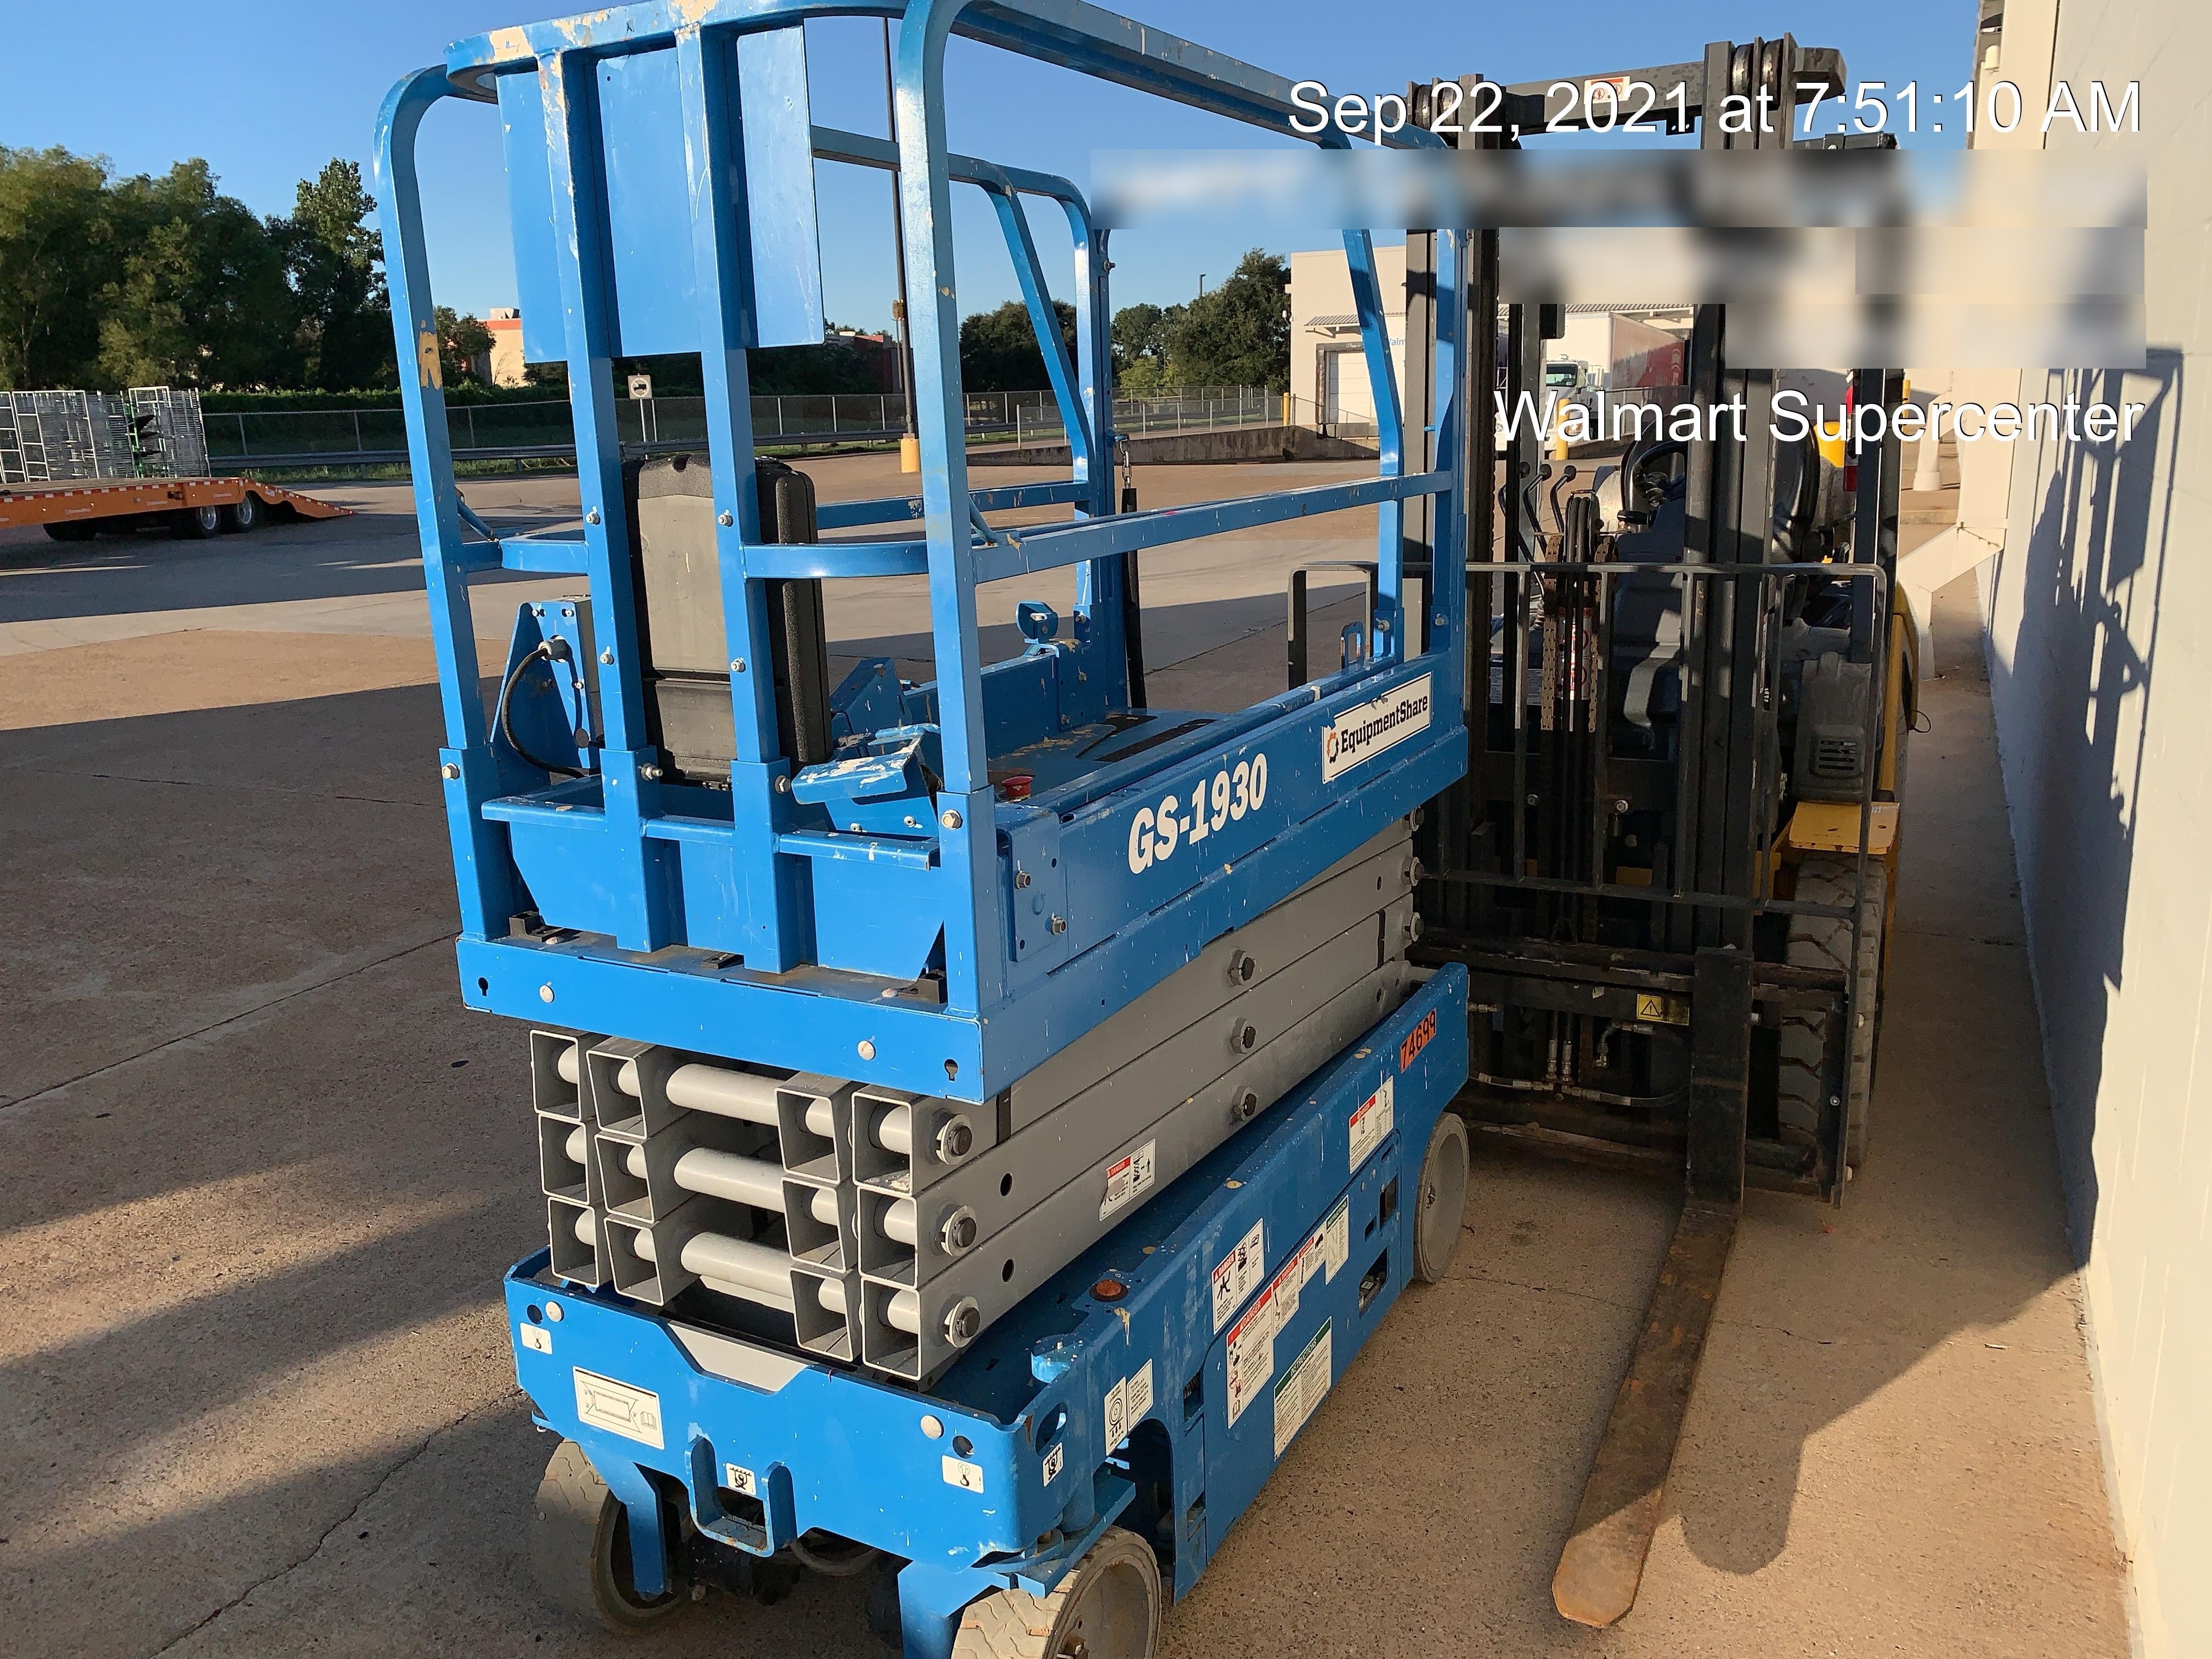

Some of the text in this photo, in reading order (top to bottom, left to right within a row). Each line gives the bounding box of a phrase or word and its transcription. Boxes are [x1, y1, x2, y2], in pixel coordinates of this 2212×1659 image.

[1340, 694, 1429, 754] EquipmentShare
[1128, 753, 1267, 874] GS-1930
[1400, 1010, 1436, 1070] 74699
[1243, 1301, 1262, 1330] DANGER
[1290, 1338, 1317, 1377] INSTRUCTIONS
